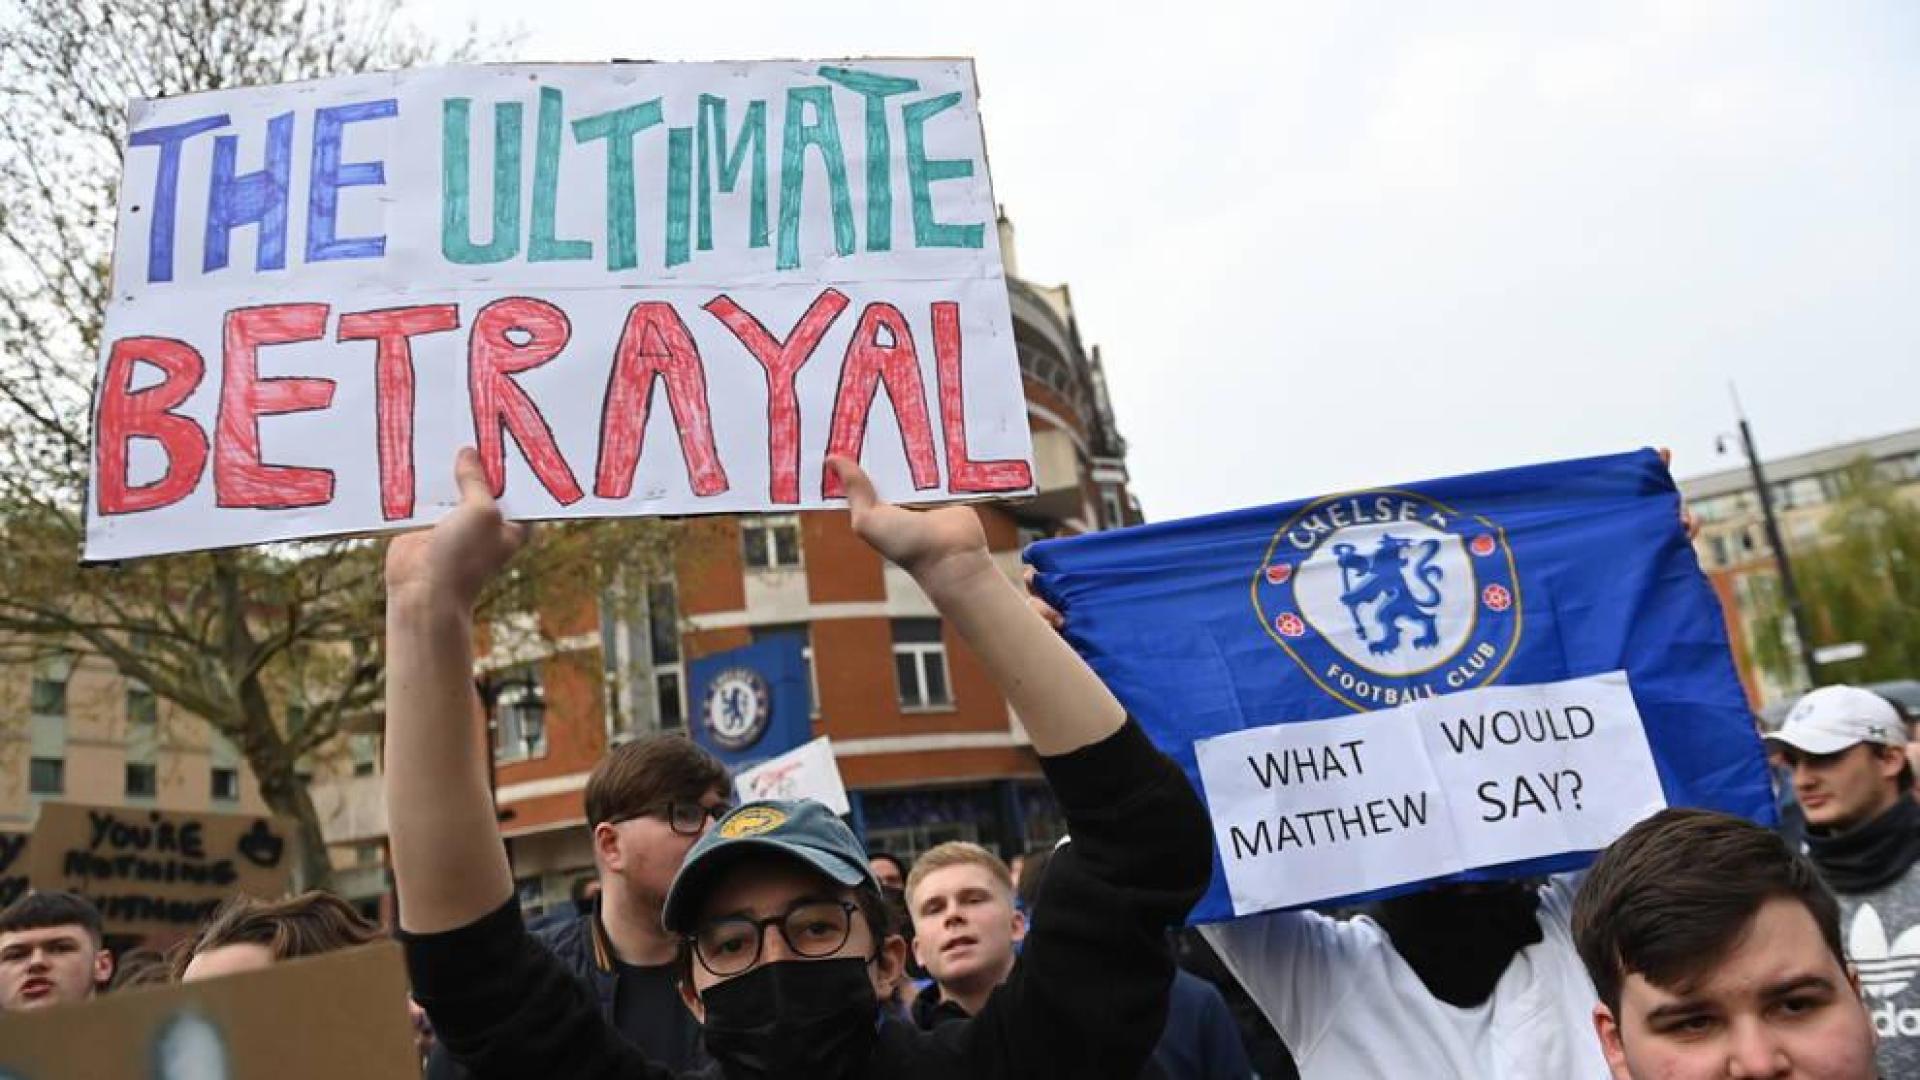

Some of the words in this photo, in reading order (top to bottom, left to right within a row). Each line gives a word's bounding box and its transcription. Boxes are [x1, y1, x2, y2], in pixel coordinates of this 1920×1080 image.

[129, 98, 398, 282] THE
[442, 66, 985, 271] ULTIMATE
[96, 289, 1032, 519] BETRAYAL
[1446, 642, 1496, 687] CLUB
[1248, 740, 1364, 789] WHAT
[1440, 705, 1595, 754] WOULD
[1230, 791, 1428, 860] MATTHEW
[1477, 768, 1584, 822] SAY?
